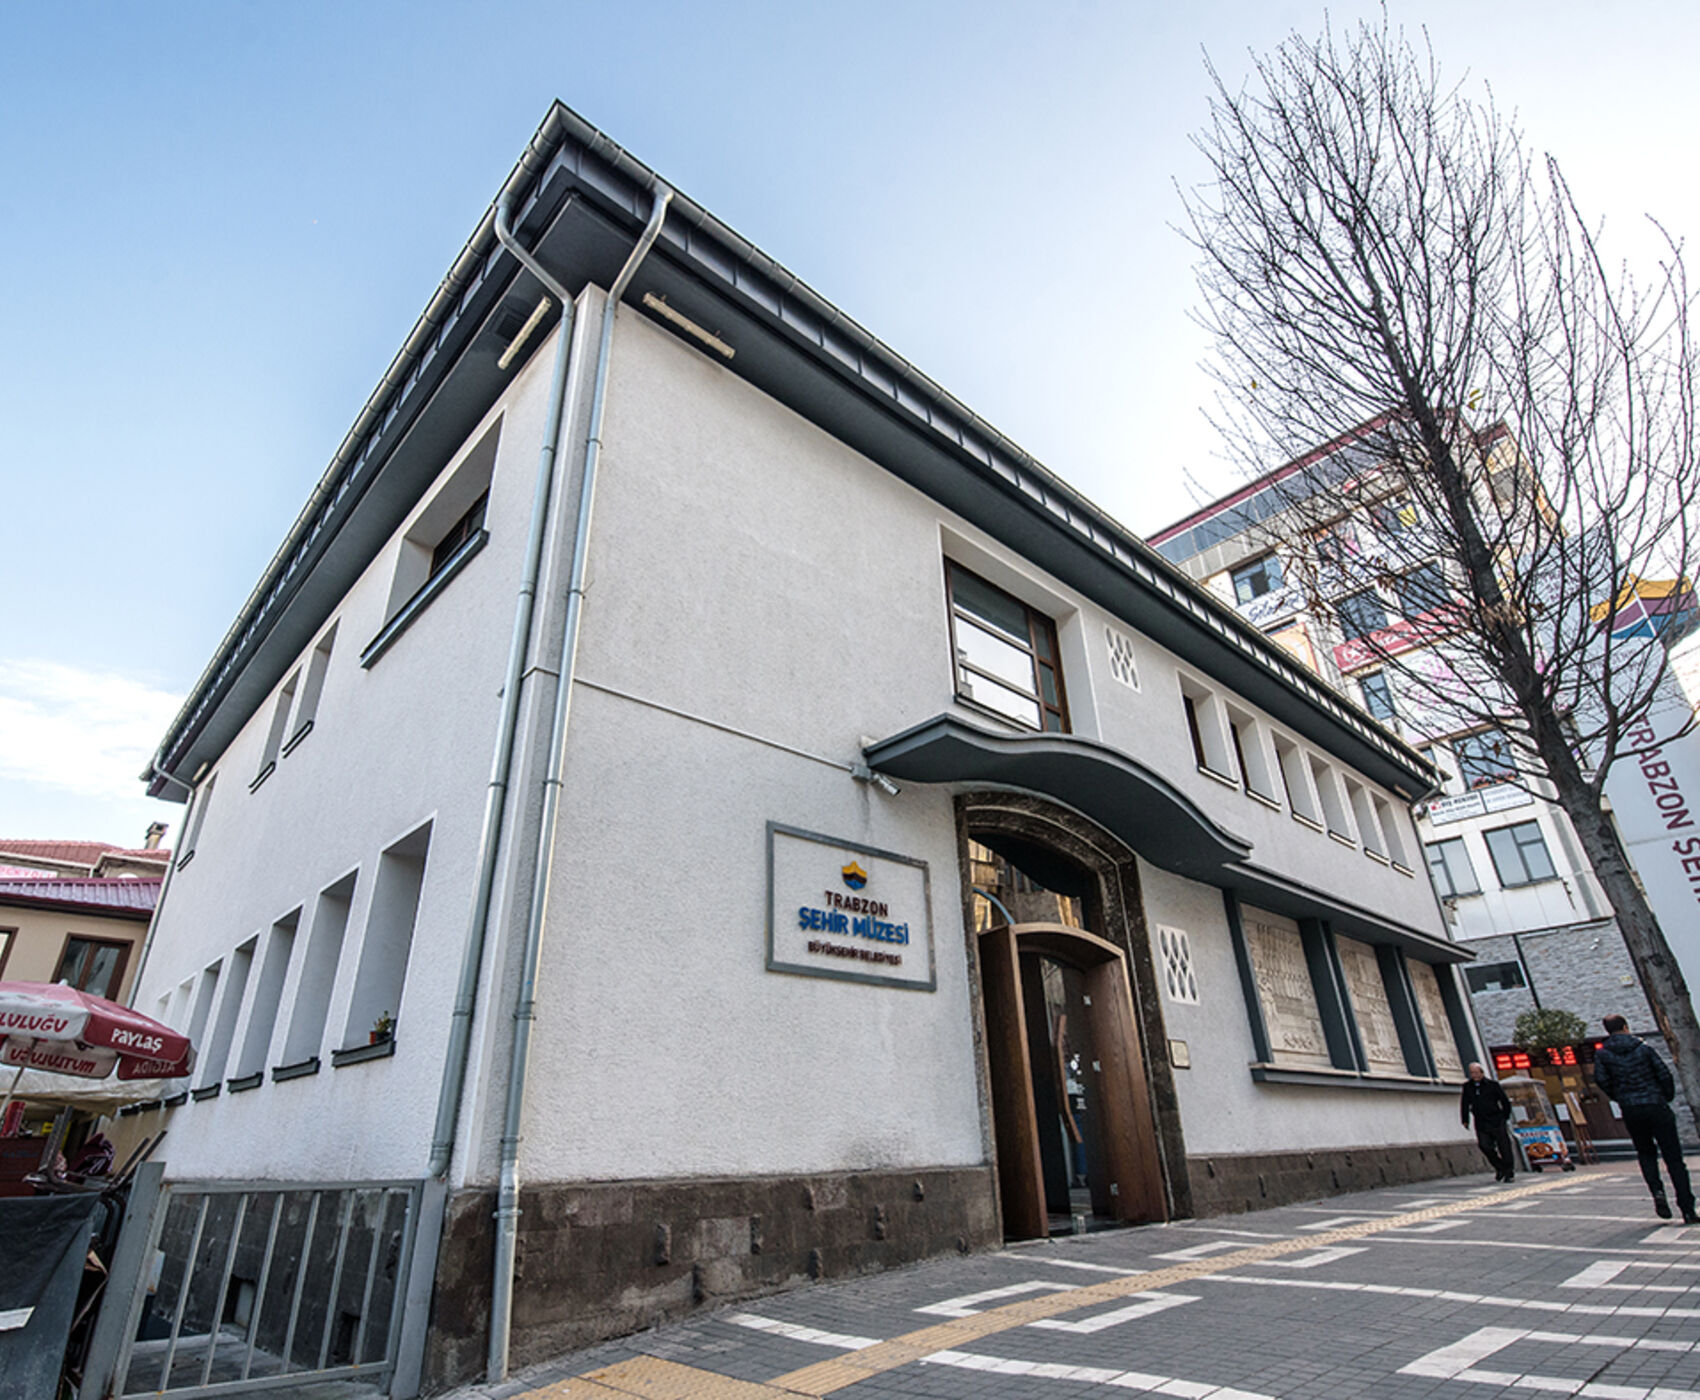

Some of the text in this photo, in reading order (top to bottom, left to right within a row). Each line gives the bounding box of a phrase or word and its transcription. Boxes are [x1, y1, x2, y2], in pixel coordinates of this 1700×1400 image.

[825, 890, 889, 917] TRABZON
[798, 906, 909, 945] ŞEHİR MÜZESİ
